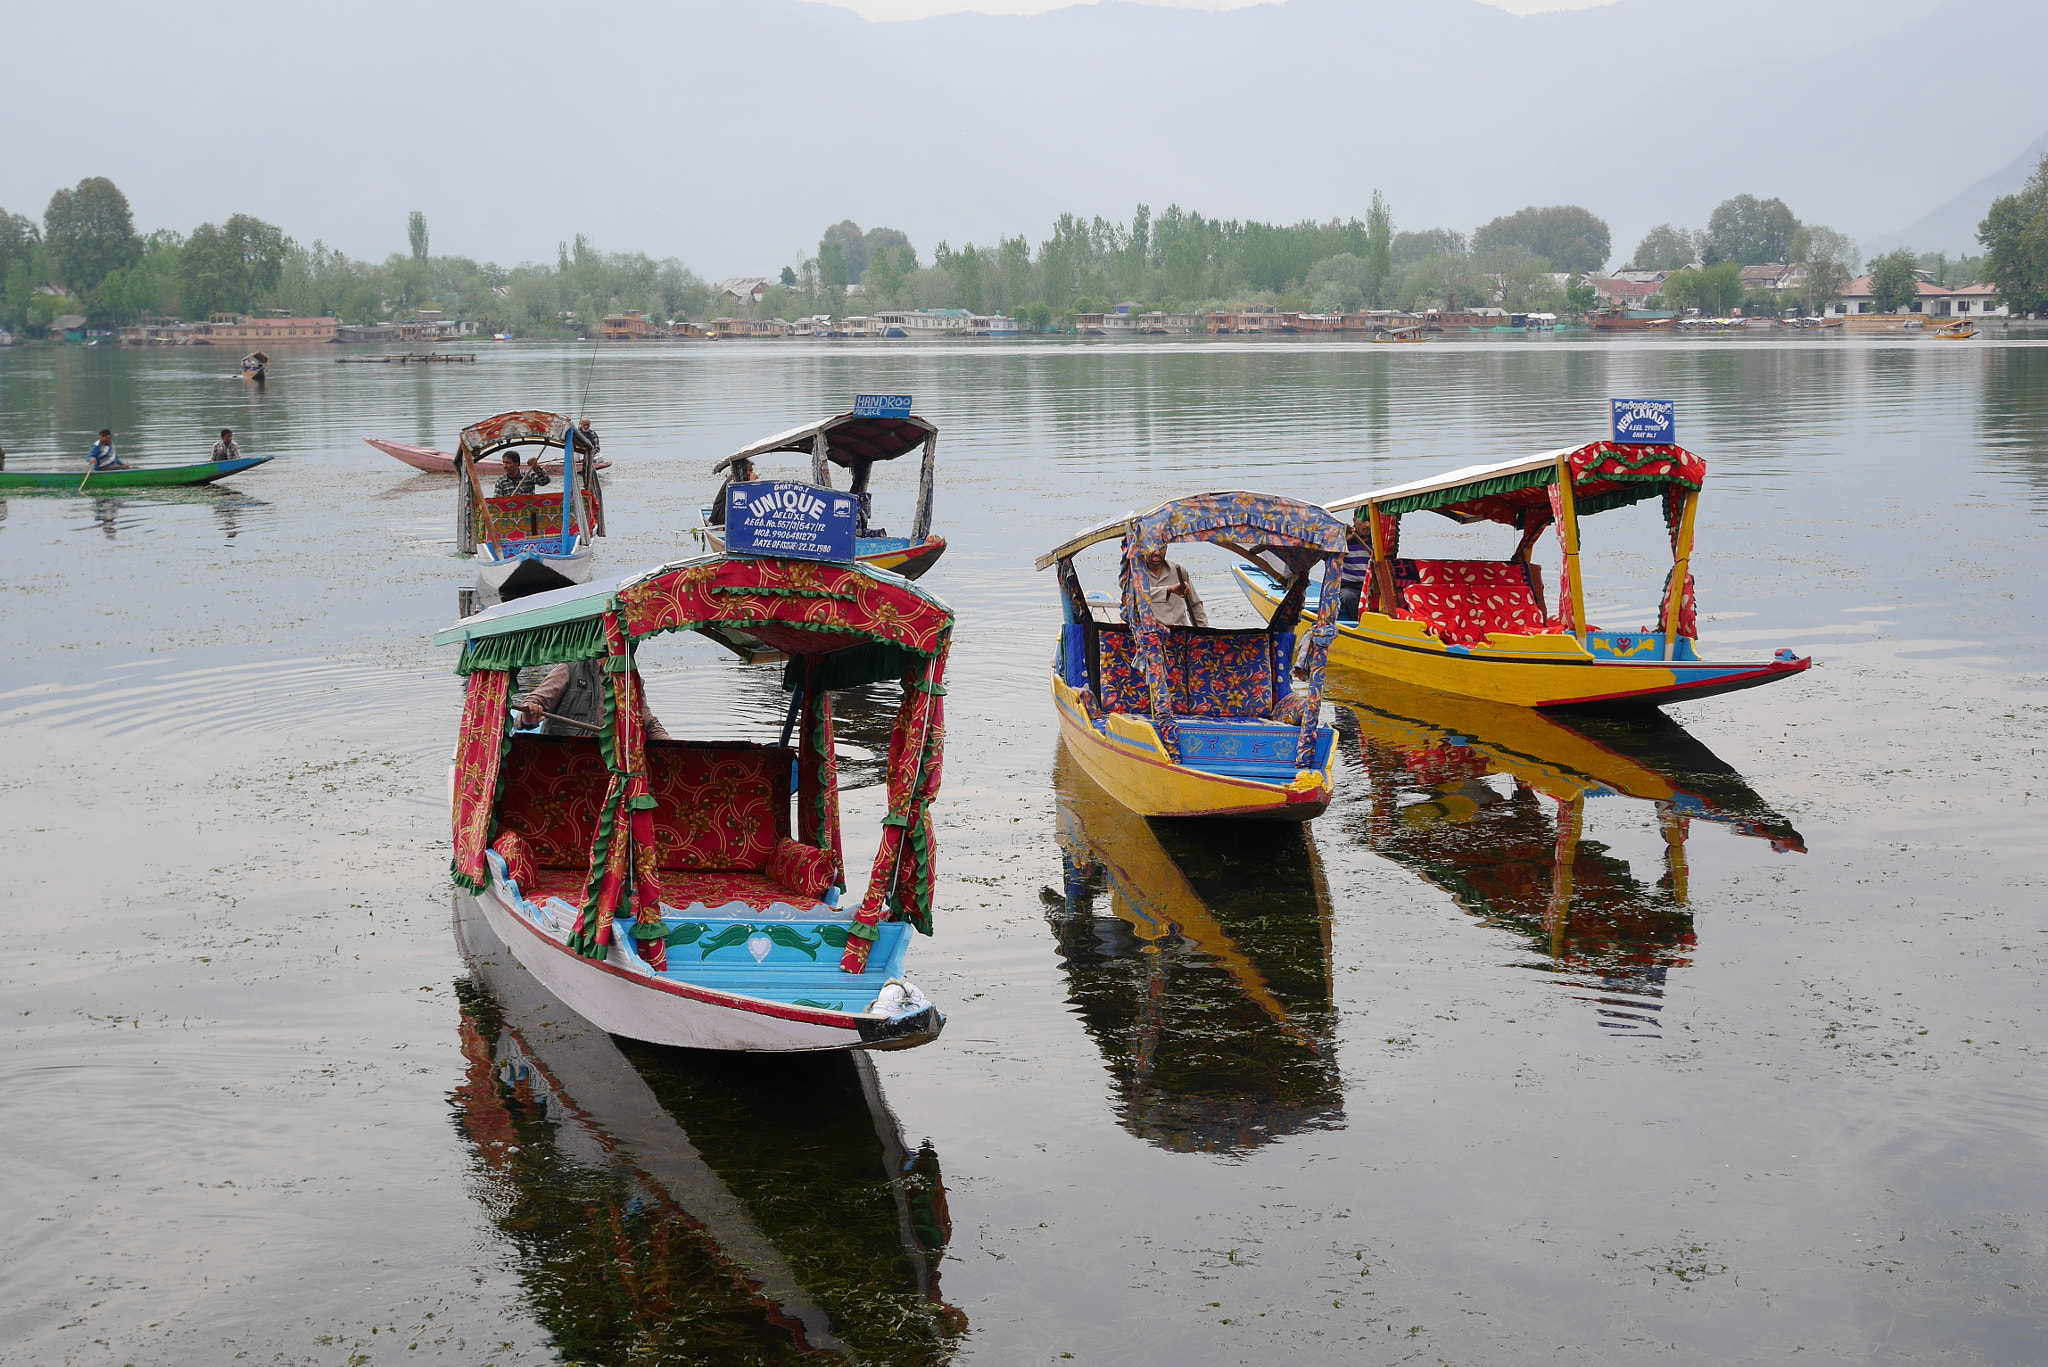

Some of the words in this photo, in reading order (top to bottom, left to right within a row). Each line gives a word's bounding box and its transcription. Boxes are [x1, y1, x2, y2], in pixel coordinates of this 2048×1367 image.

[857, 396, 910, 408] HANDROO
[1616, 412, 1633, 433] NEW
[1633, 408, 1669, 430] CANADA
[749, 490, 826, 520] UNIQUE
[772, 510, 805, 521] DELUXE
[753, 538, 771, 547] DATE
